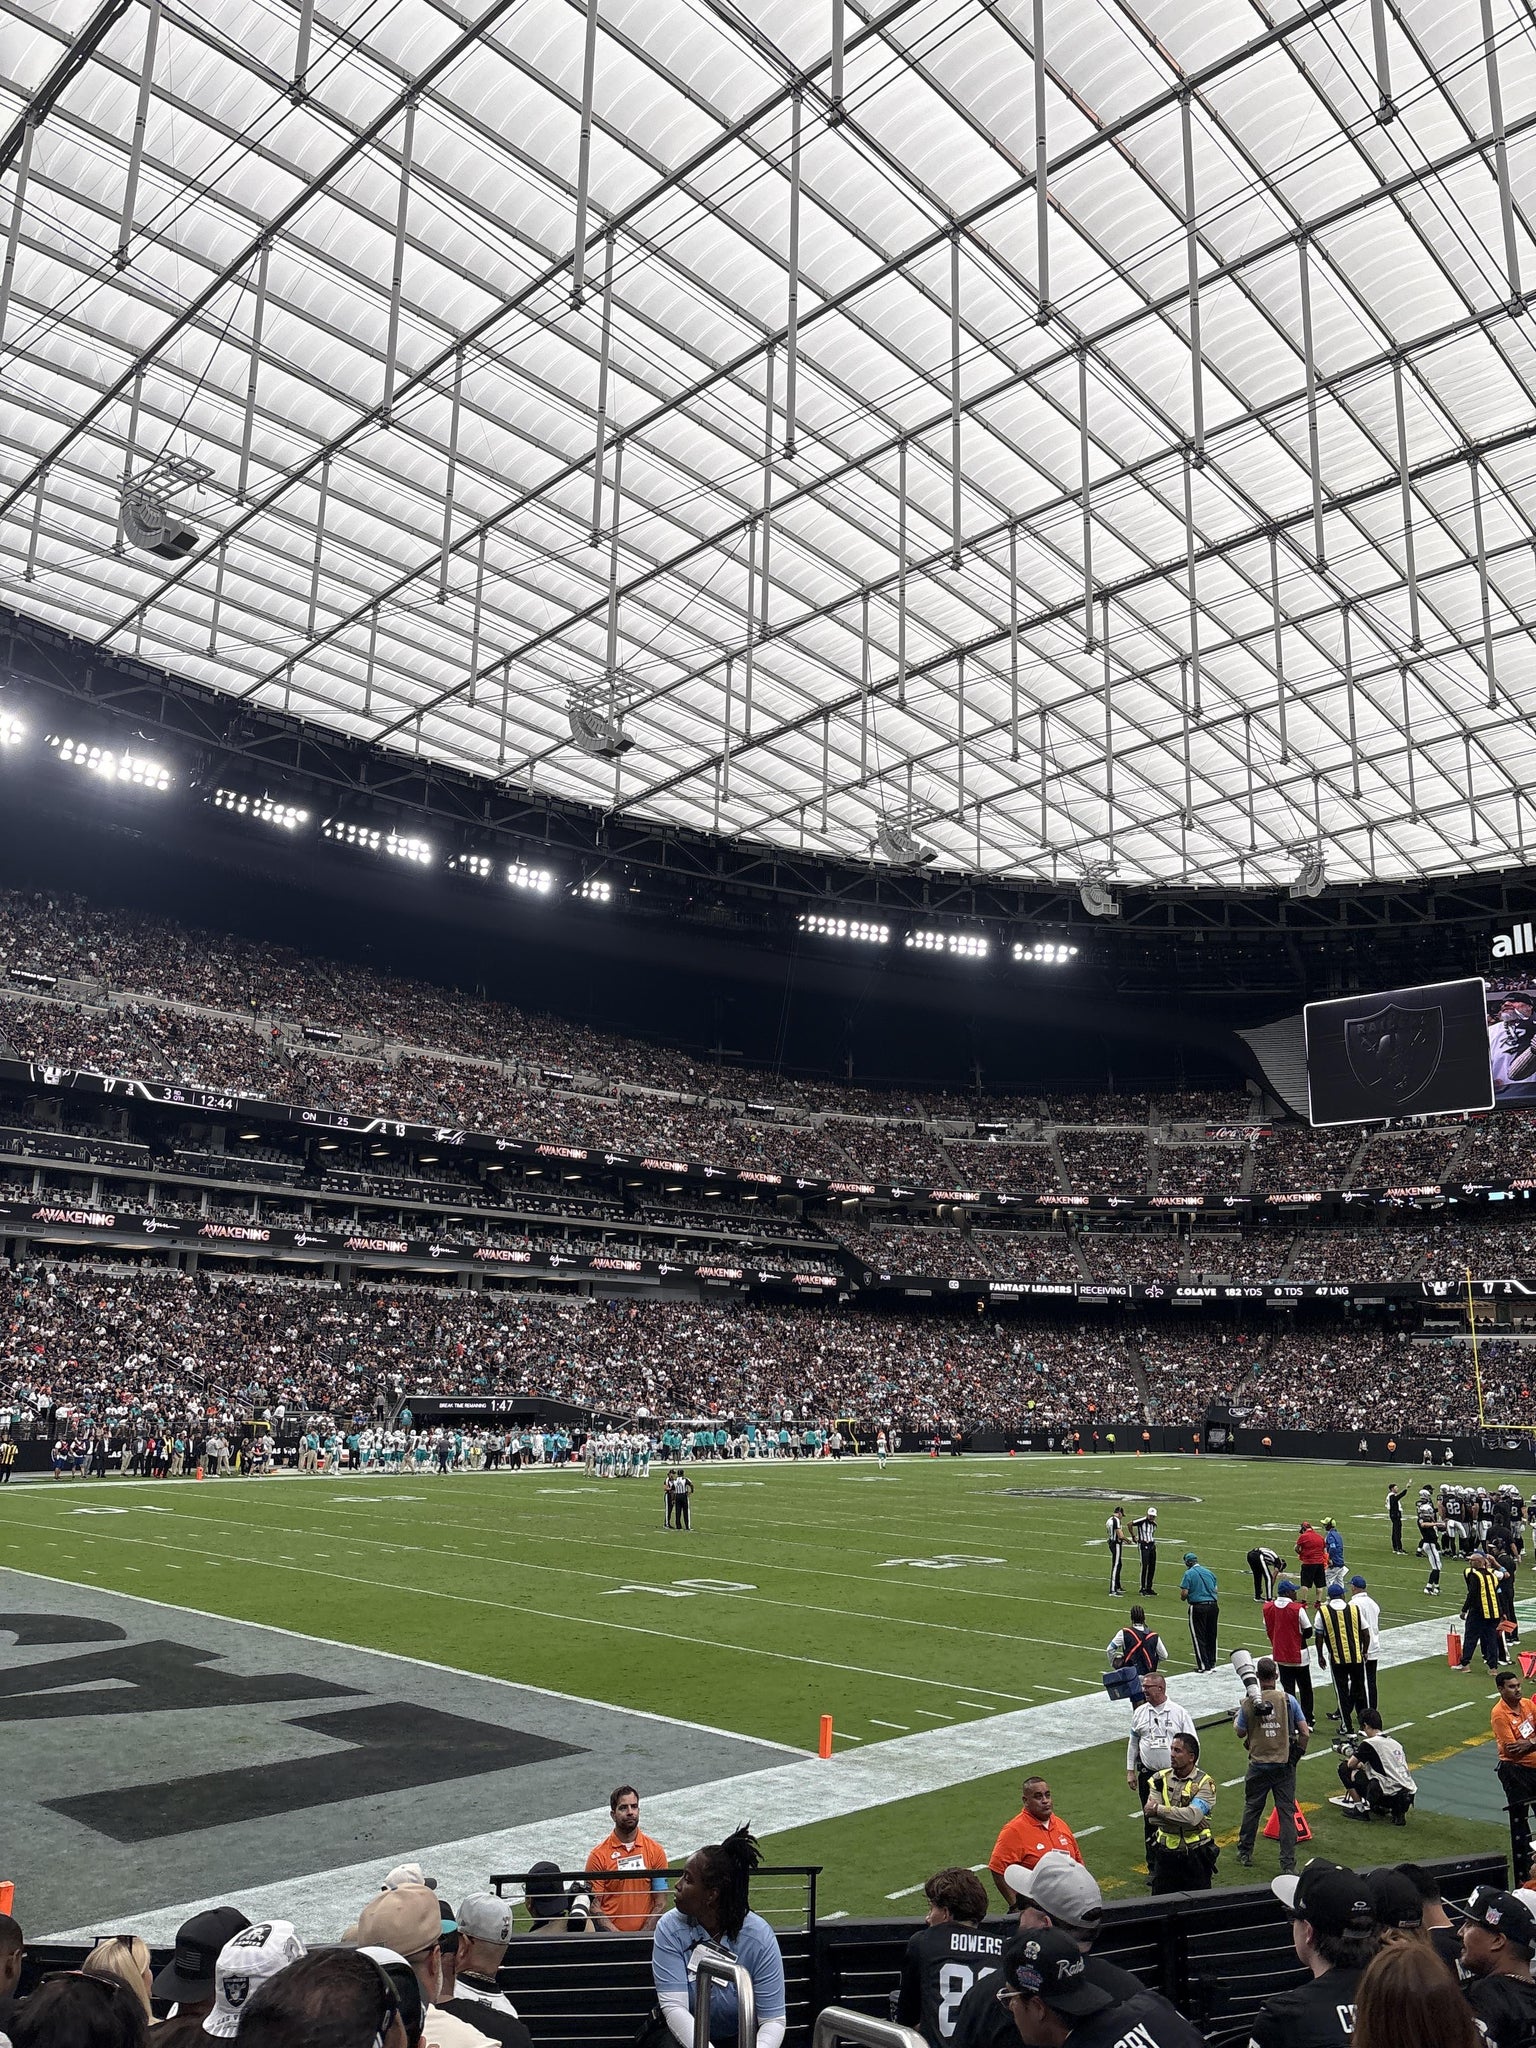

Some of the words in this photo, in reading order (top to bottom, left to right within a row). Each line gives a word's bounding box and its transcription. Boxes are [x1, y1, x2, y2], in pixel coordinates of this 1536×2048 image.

[1492, 922, 1536, 958] all
[103, 1078, 116, 1093] 17
[163, 1088, 171, 1100] 3
[201, 1095, 233, 1109] 12:44
[302, 1112, 316, 1121] ON
[338, 1117, 349, 1126] 25
[396, 1124, 405, 1136] 13
[535, 1144, 587, 1160] AWAKENING
[640, 1158, 688, 1172] AWAKENING
[737, 1171, 781, 1184] AWAKENING
[828, 1182, 875, 1194] AWAKENING
[929, 1191, 980, 1200] AWAKENING
[1035, 1196, 1089, 1205] AWAKENING
[1148, 1197, 1204, 1207] AWAKENING
[1265, 1193, 1321, 1204] AWAKENING
[1383, 1186, 1441, 1198] AWAKENING
[32, 1207, 115, 1226] AWAKENING
[198, 1224, 270, 1241] AWAKENING
[343, 1237, 408, 1252] AWAKENING
[473, 1248, 531, 1262] AWAKENING
[589, 1257, 641, 1271] AWAKENING
[695, 1266, 742, 1279] AWAKENING
[792, 1273, 836, 1286] AWAKENING
[989, 1283, 1030, 1292] FANTASY
[1032, 1285, 1072, 1294] LEADERS
[1080, 1286, 1126, 1295] RECEIVING
[1225, 1288, 1241, 1296] 182
[1244, 1288, 1262, 1296] YDS
[1284, 1288, 1303, 1296] TDS
[1315, 1287, 1328, 1295] 47
[1330, 1287, 1349, 1295] LNG
[1483, 1282, 1494, 1294] 17
[491, 1400, 513, 1412] 1:47
[1446, 1502, 1460, 1514] 82
[1482, 1501, 1491, 1513] 41
[620, 1578, 758, 1597] 10
[950, 1933, 1002, 1955] BOWERS
